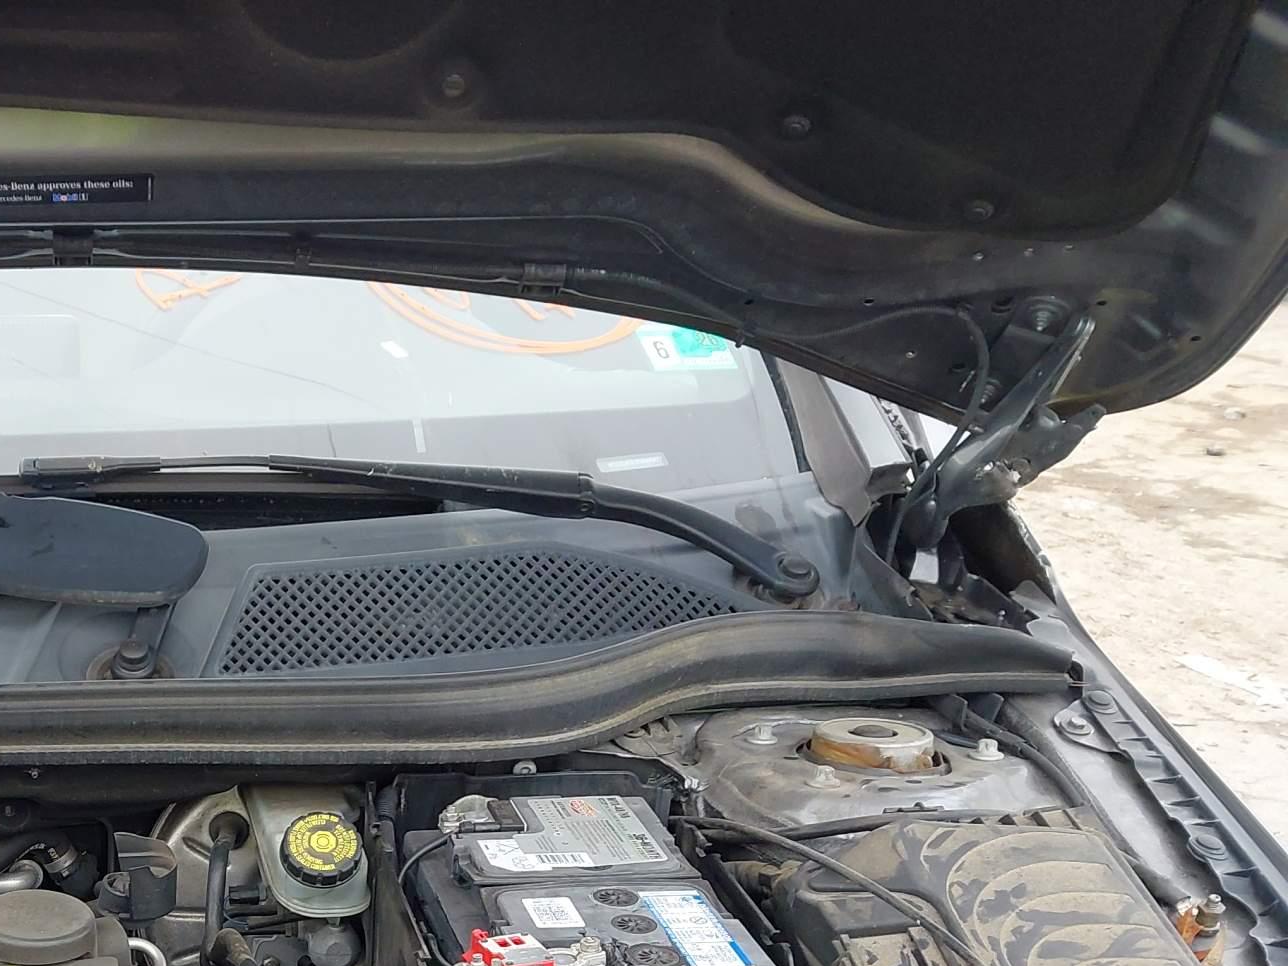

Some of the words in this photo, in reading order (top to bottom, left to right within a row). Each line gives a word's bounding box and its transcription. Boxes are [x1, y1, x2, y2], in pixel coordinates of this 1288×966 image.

[37, 181, 81, 192] approves
[83, 179, 110, 189] these
[653, 341, 669, 359] 6
